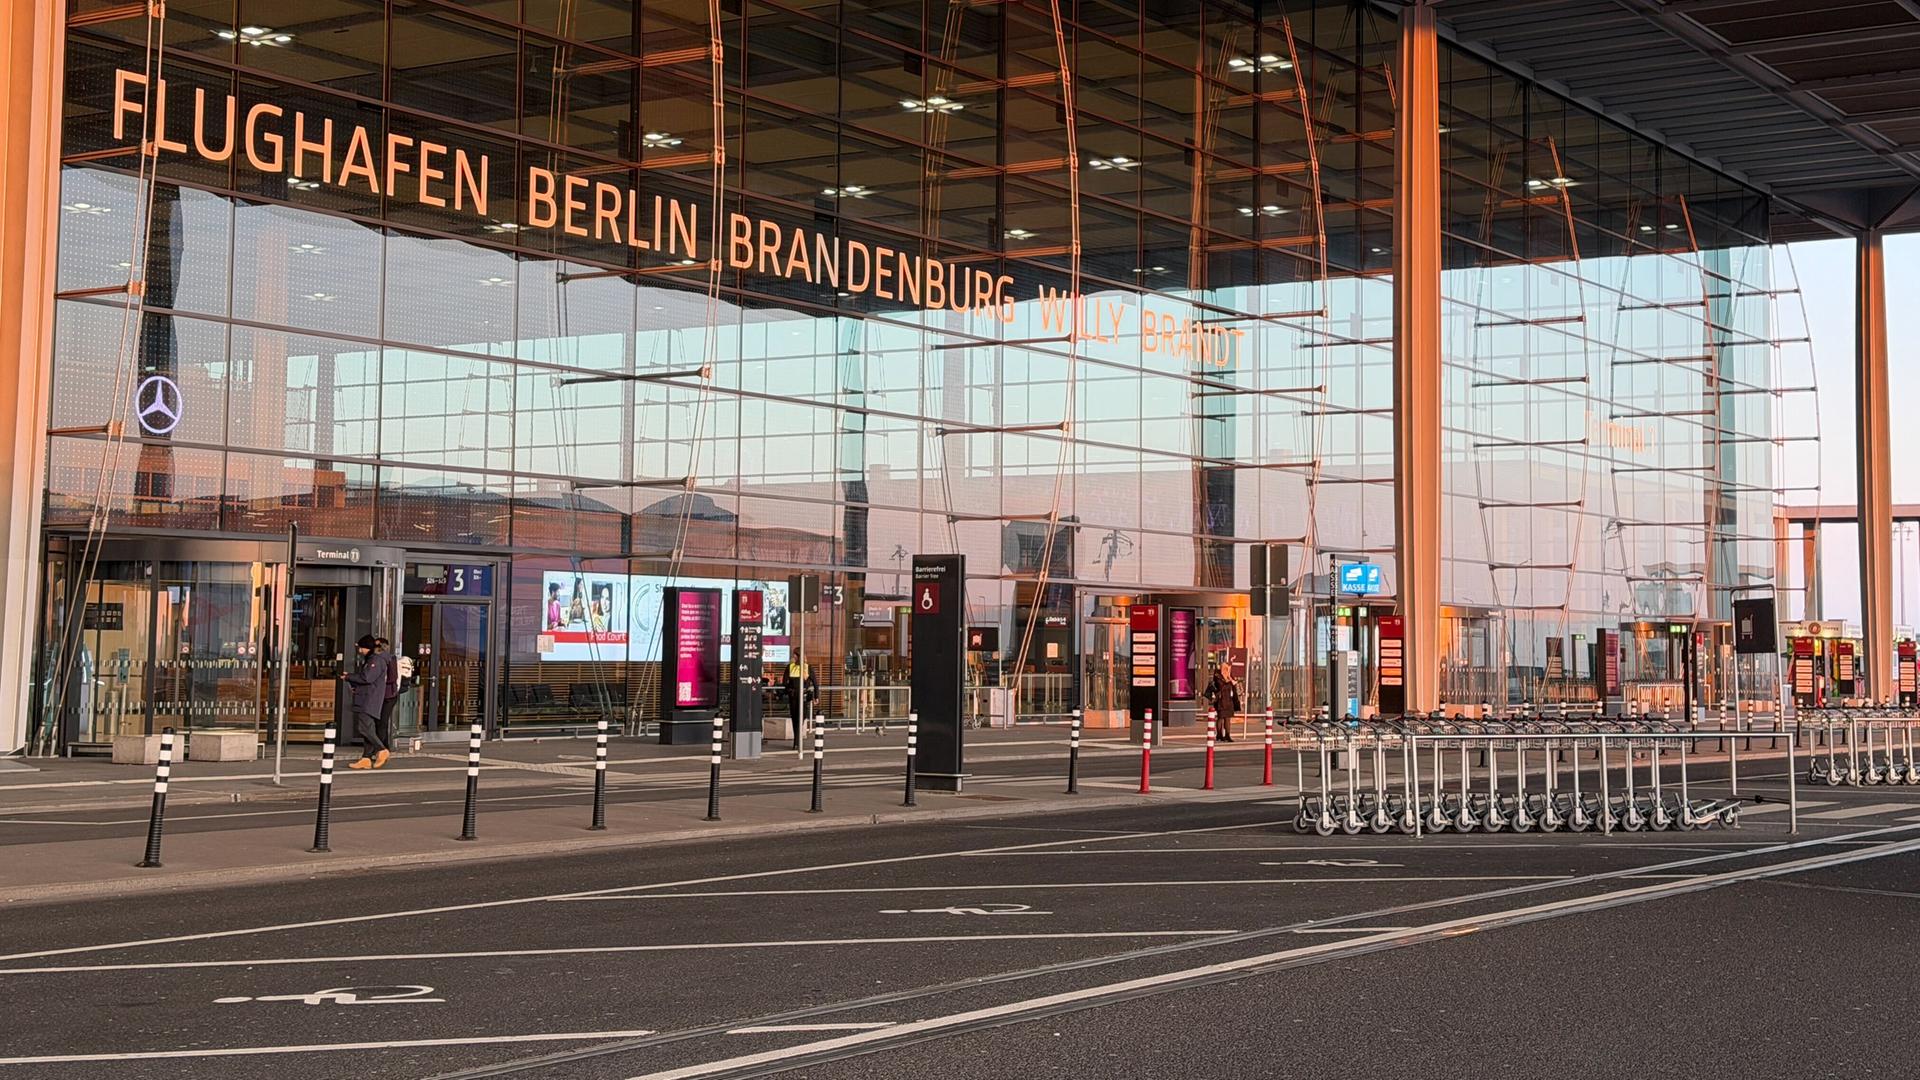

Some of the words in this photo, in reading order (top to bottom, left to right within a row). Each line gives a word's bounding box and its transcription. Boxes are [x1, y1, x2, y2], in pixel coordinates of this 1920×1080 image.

[113, 68, 488, 216] FLUGHAFEN
[528, 166, 697, 258] BERLIN
[730, 212, 1016, 323] BRANDENBURG
[1038, 284, 1124, 344] WILLY
[1142, 309, 1245, 369] BRANDT
[316, 549, 350, 560] Terminal
[915, 565, 946, 573] Barrierefrei
[453, 568, 464, 592] 3
[1342, 583, 1366, 592] KASSE
[834, 585, 844, 605] 3
[607, 632, 627, 642] Court
